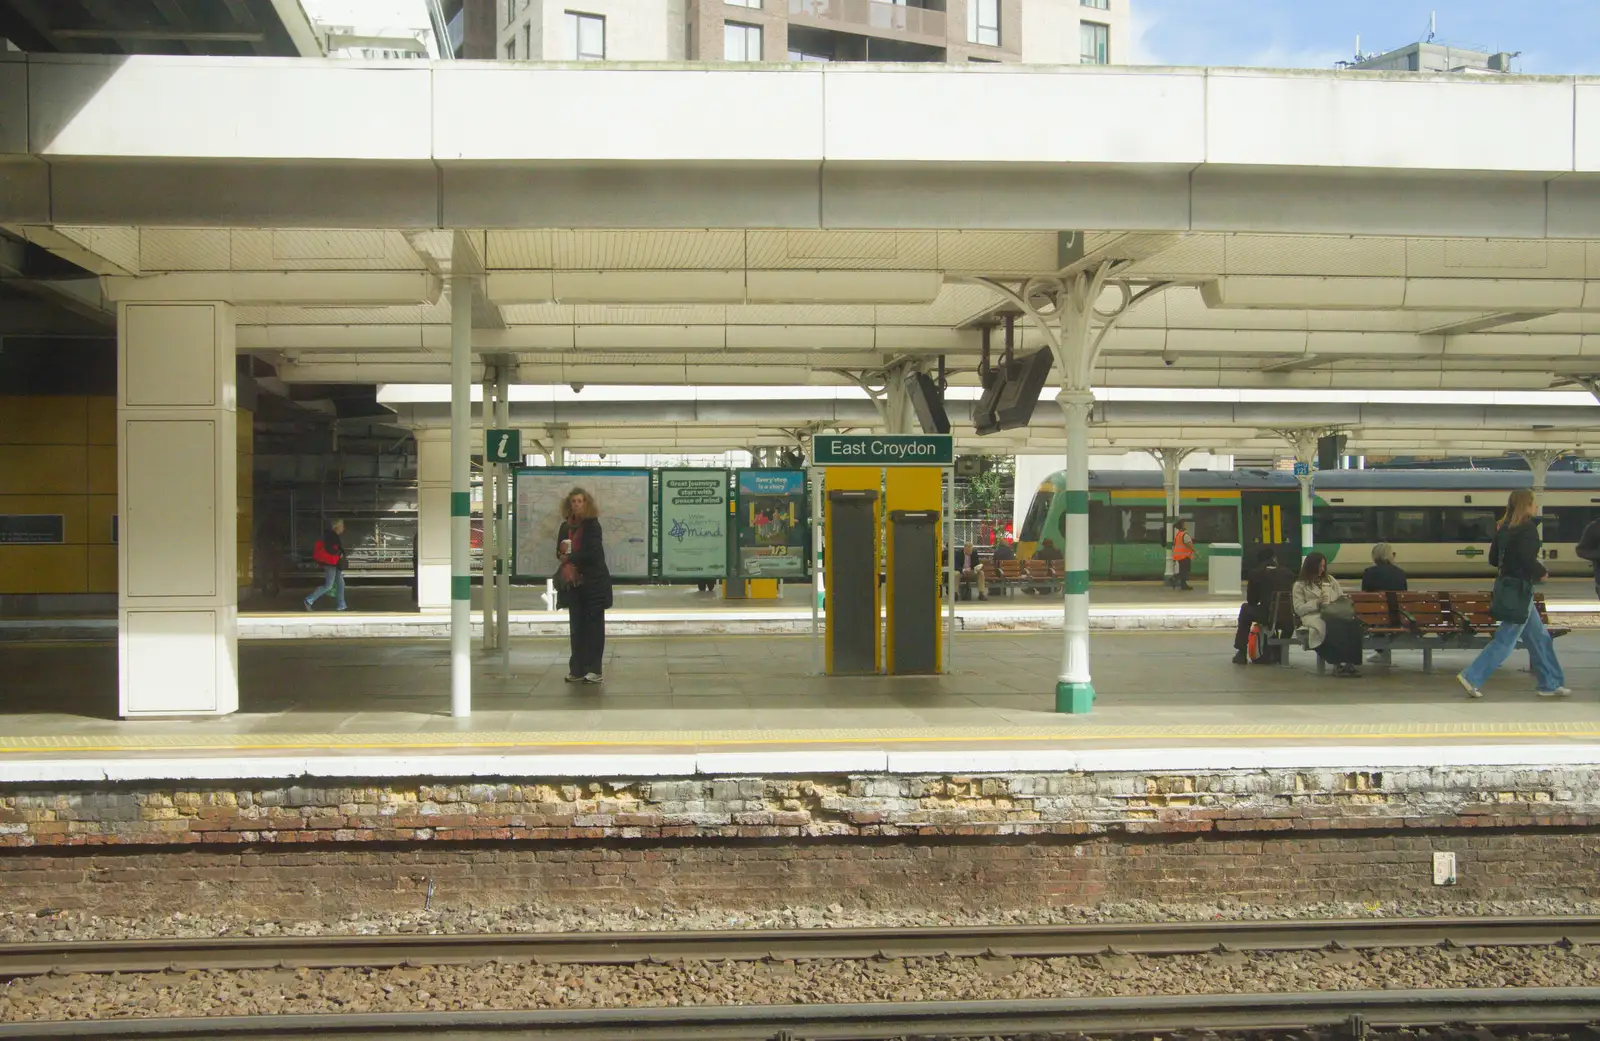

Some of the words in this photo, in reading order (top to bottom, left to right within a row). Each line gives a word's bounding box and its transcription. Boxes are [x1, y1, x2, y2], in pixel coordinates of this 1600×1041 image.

[831, 440, 866, 455] East
[871, 440, 936, 458] Croydon
[675, 497, 694, 505] peace
